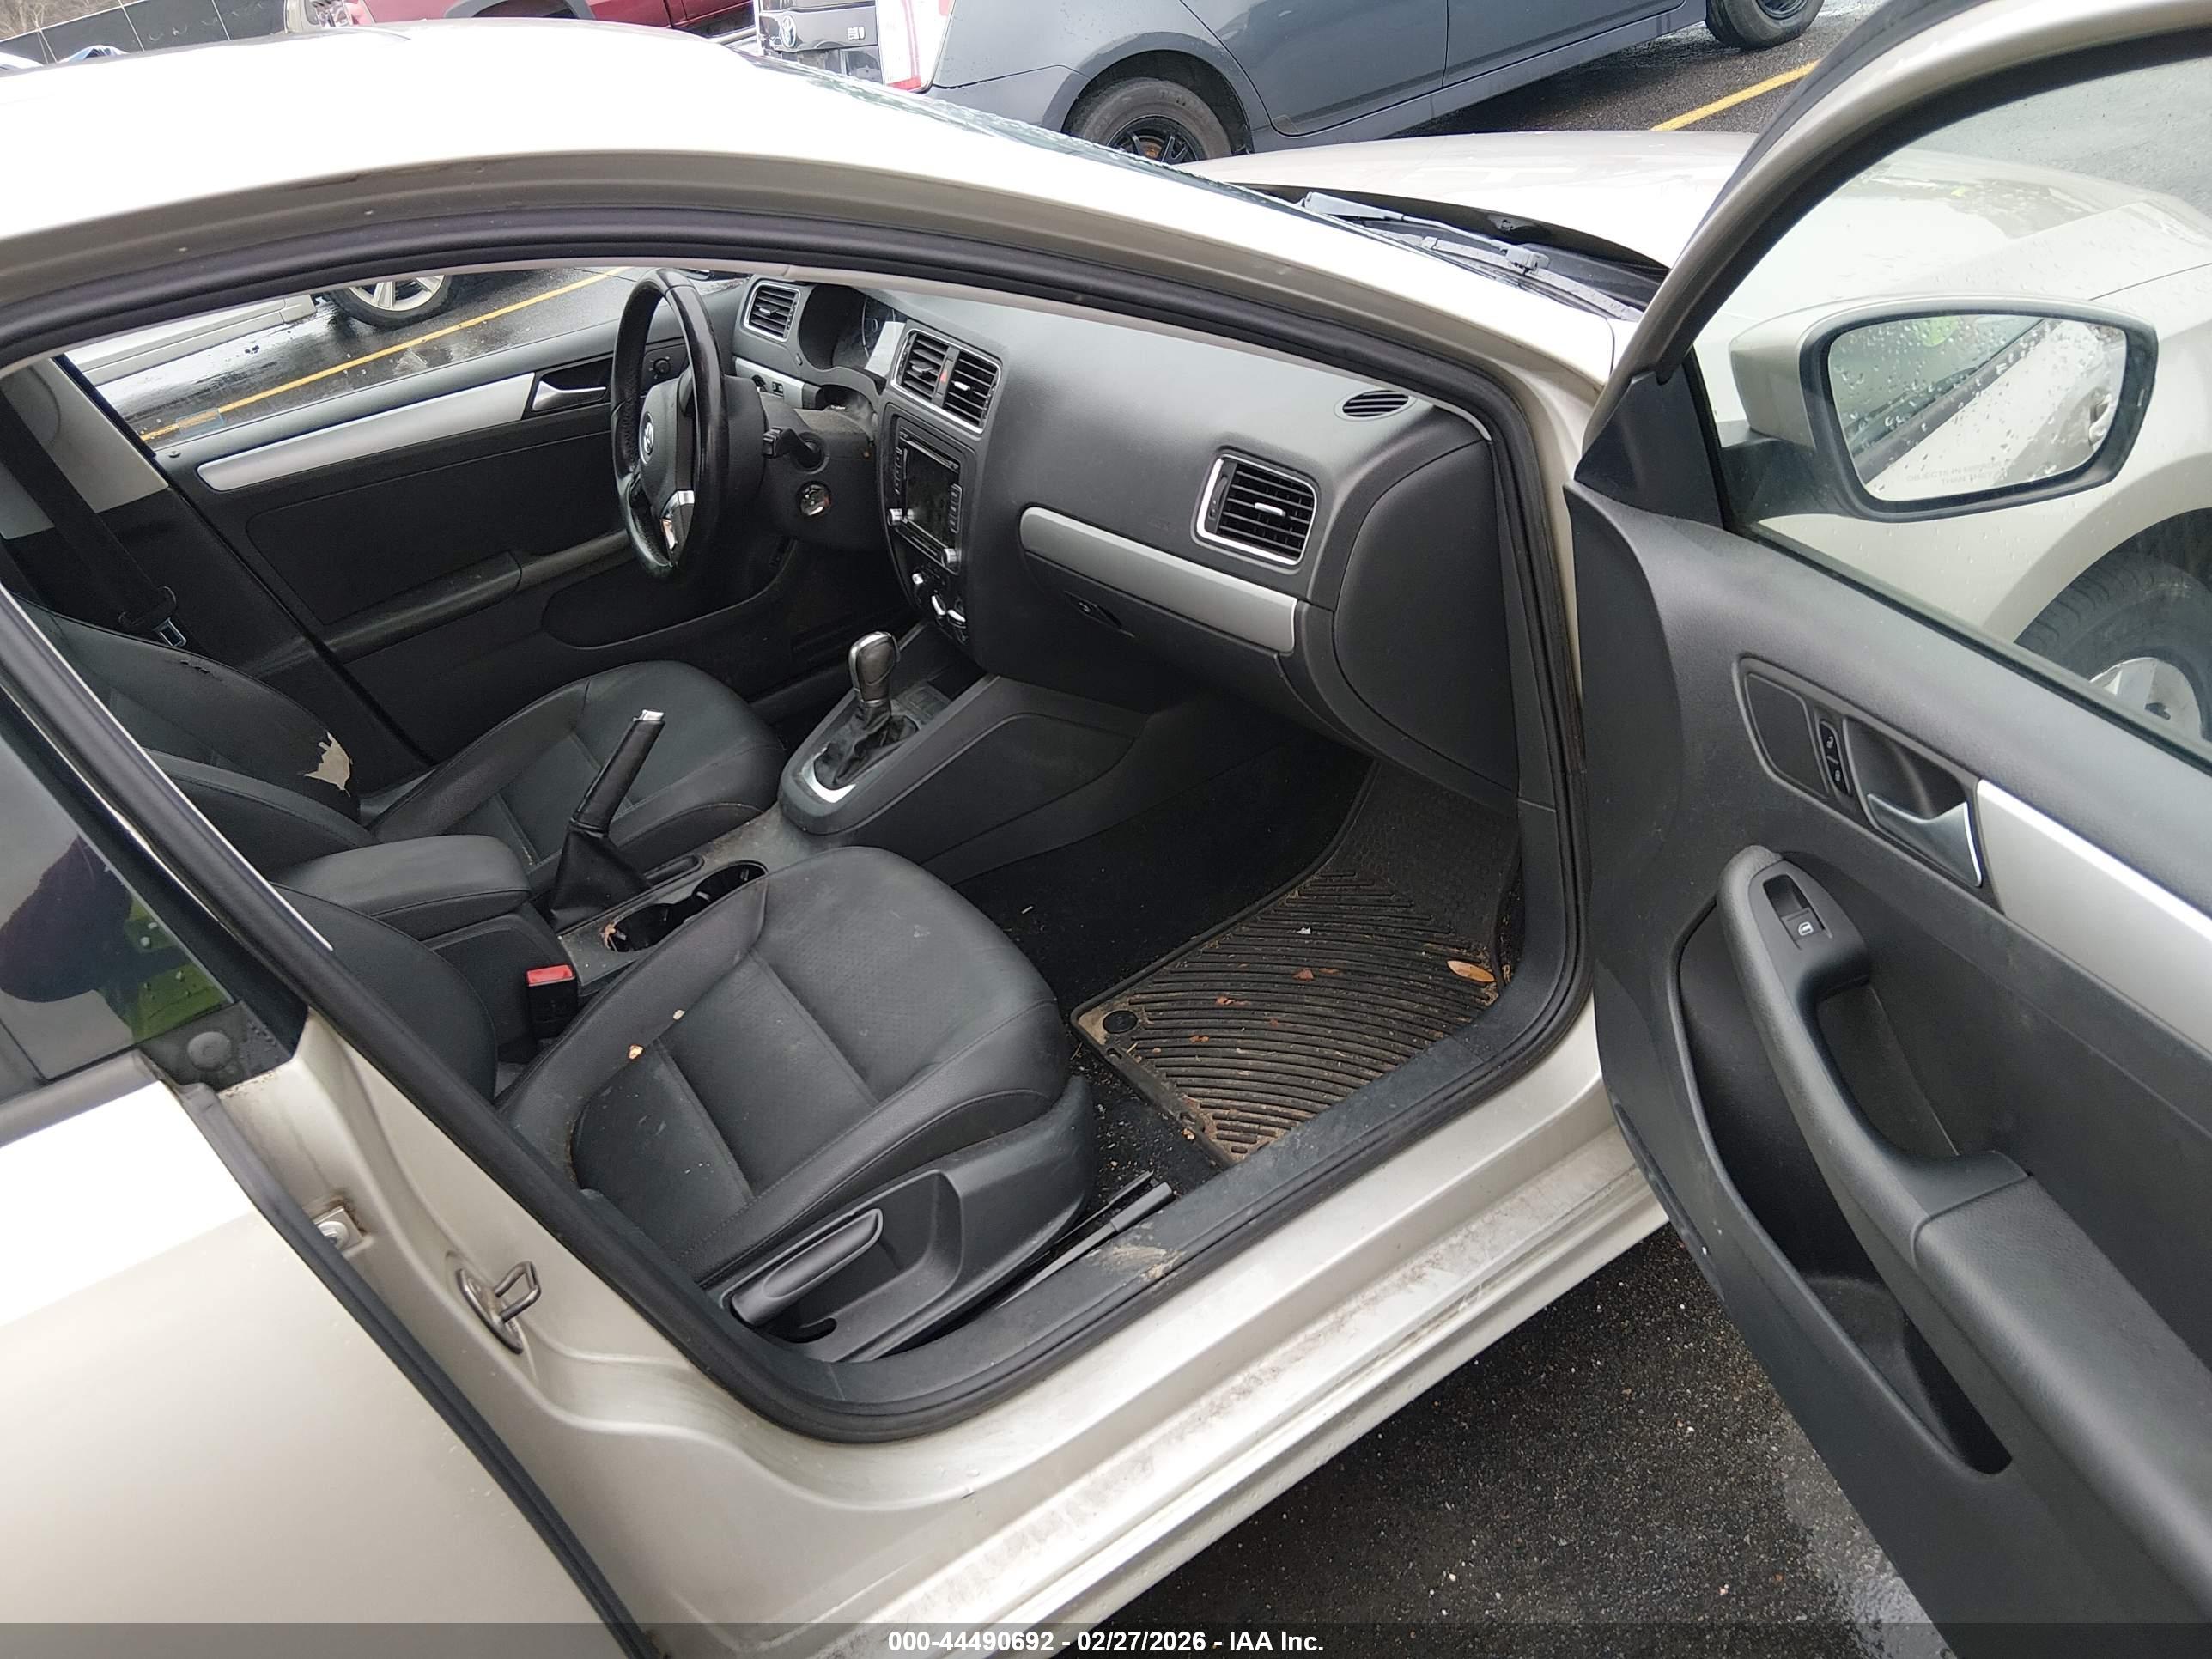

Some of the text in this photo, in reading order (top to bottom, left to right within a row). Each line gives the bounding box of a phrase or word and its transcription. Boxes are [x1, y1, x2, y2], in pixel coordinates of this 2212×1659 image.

[1905, 468, 1949, 482] OBJECTS
[1951, 466, 1962, 475] IN
[1942, 474, 1966, 485] THAN
